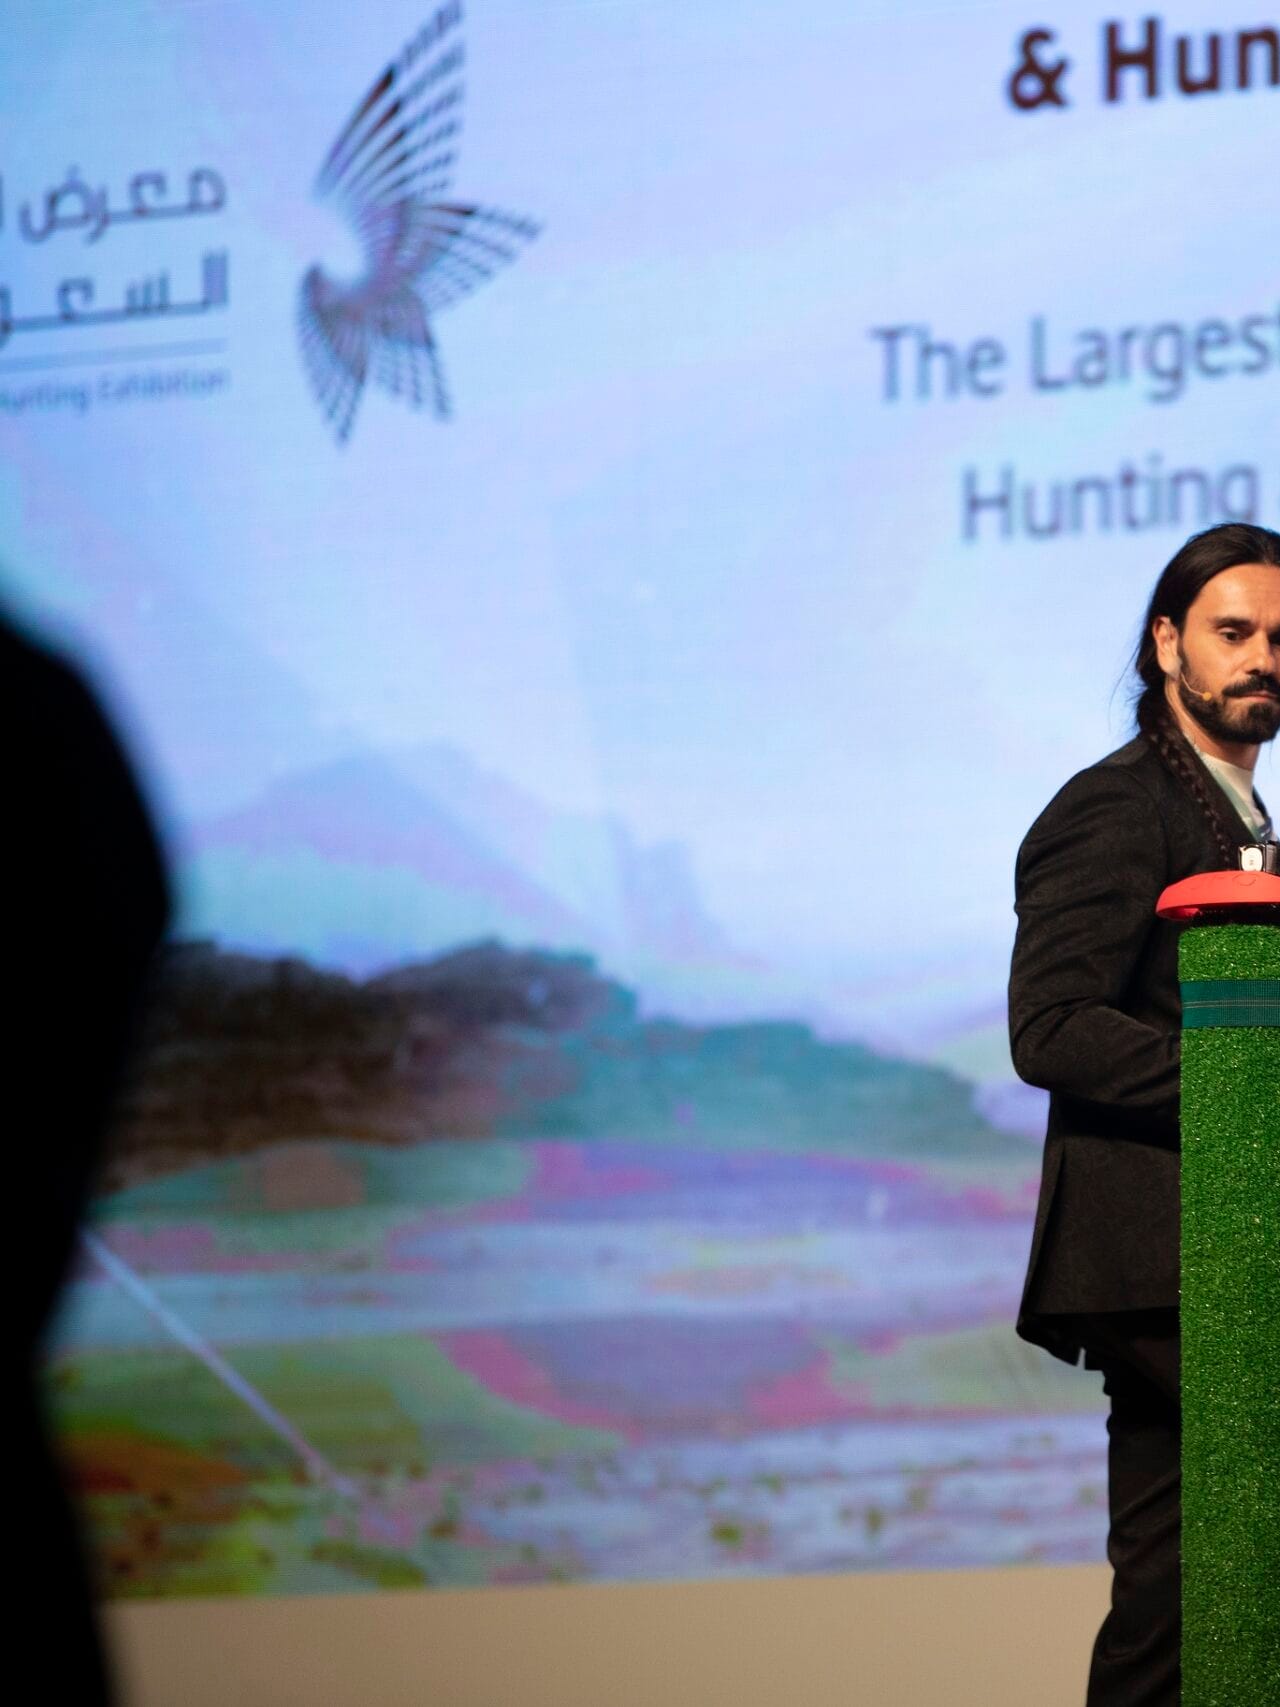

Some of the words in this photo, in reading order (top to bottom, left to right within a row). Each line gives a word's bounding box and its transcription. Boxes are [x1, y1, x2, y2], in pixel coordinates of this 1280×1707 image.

[1007, 26, 1071, 112] &
[18, 165, 226, 243] معرض
[0, 384, 89, 418] unting
[869, 322, 1006, 404] The
[963, 455, 1259, 542] Hunting
